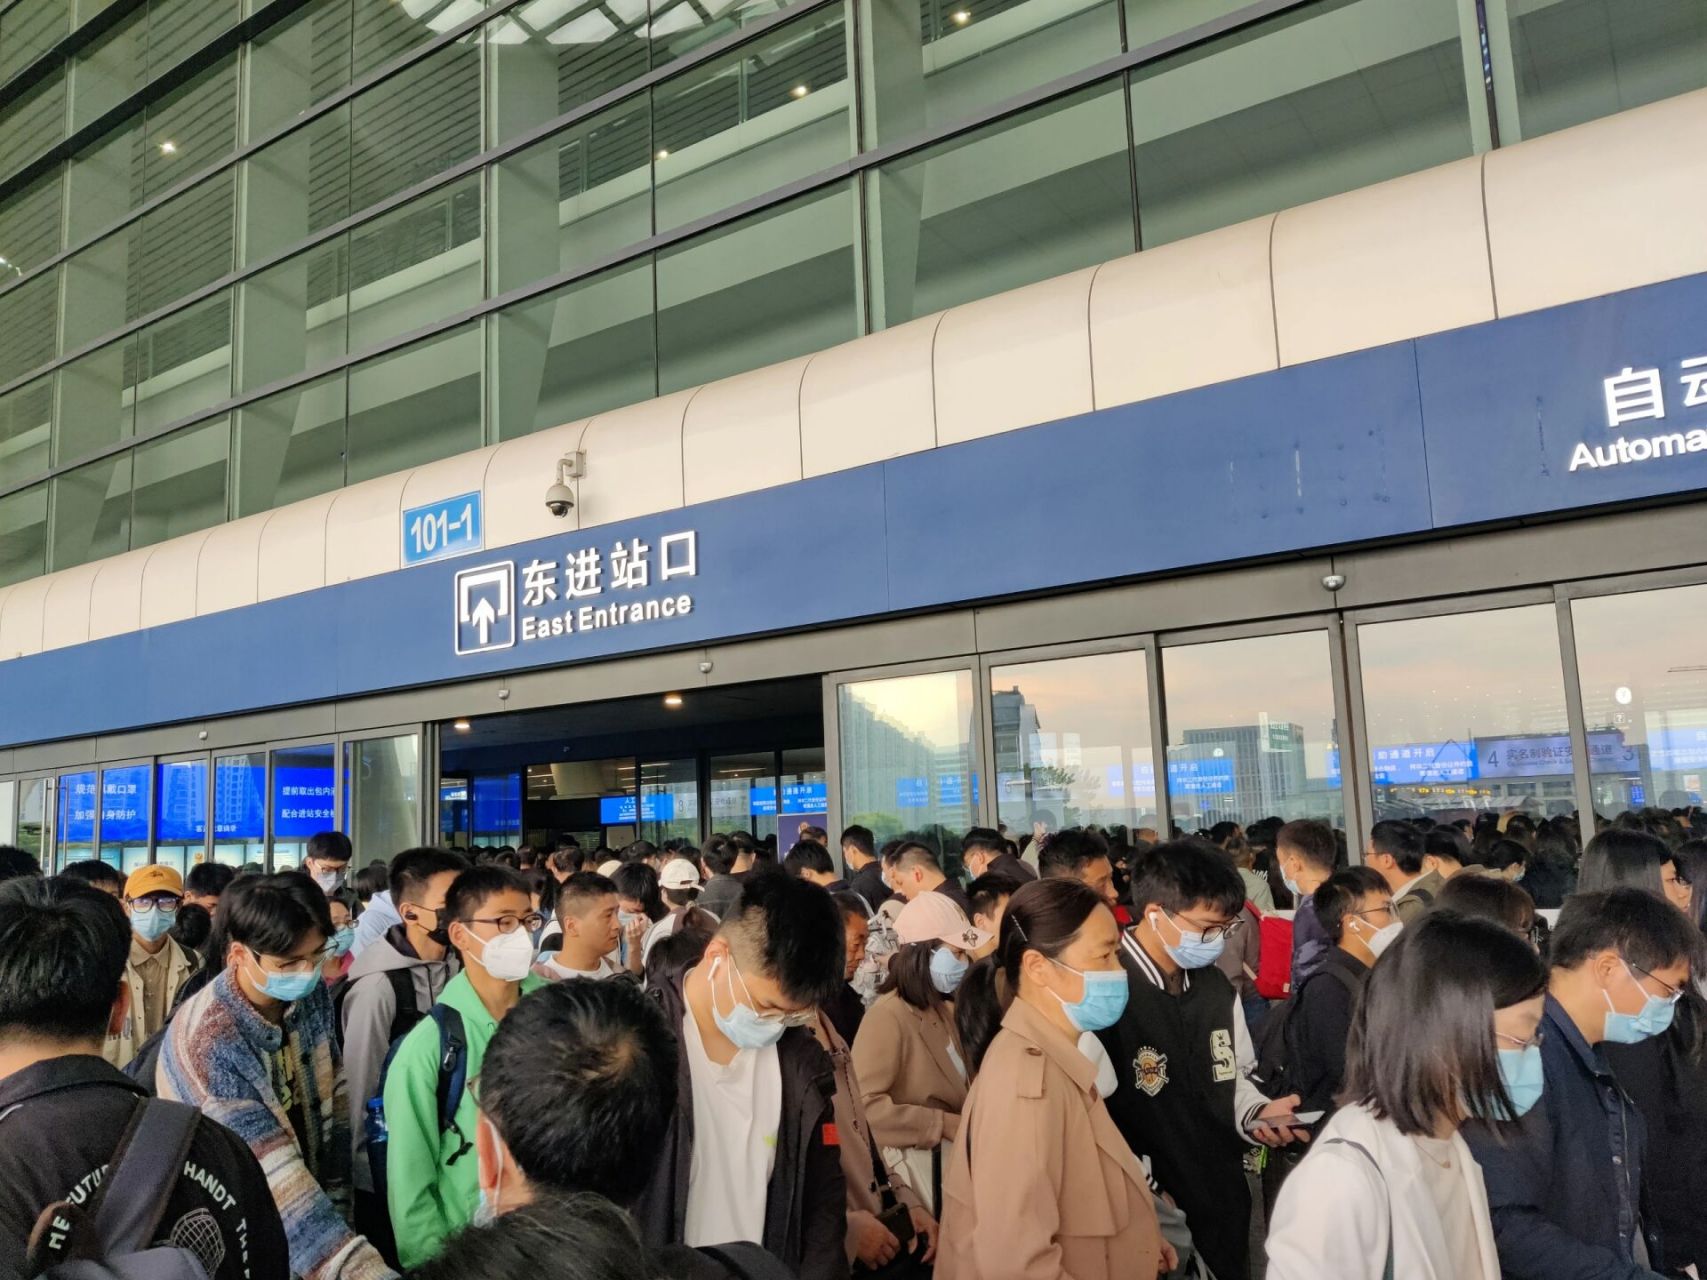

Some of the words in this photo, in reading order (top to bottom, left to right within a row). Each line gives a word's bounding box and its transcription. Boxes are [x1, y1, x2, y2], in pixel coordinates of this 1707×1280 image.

[1568, 429, 1707, 472] Automa
[410, 502, 473, 554] 101-1
[522, 529, 696, 607] 东进站口
[521, 612, 573, 641] East
[578, 594, 692, 631] Entrance
[75, 783, 137, 795] 规范戴口罩
[74, 809, 137, 820] 加强身防护
